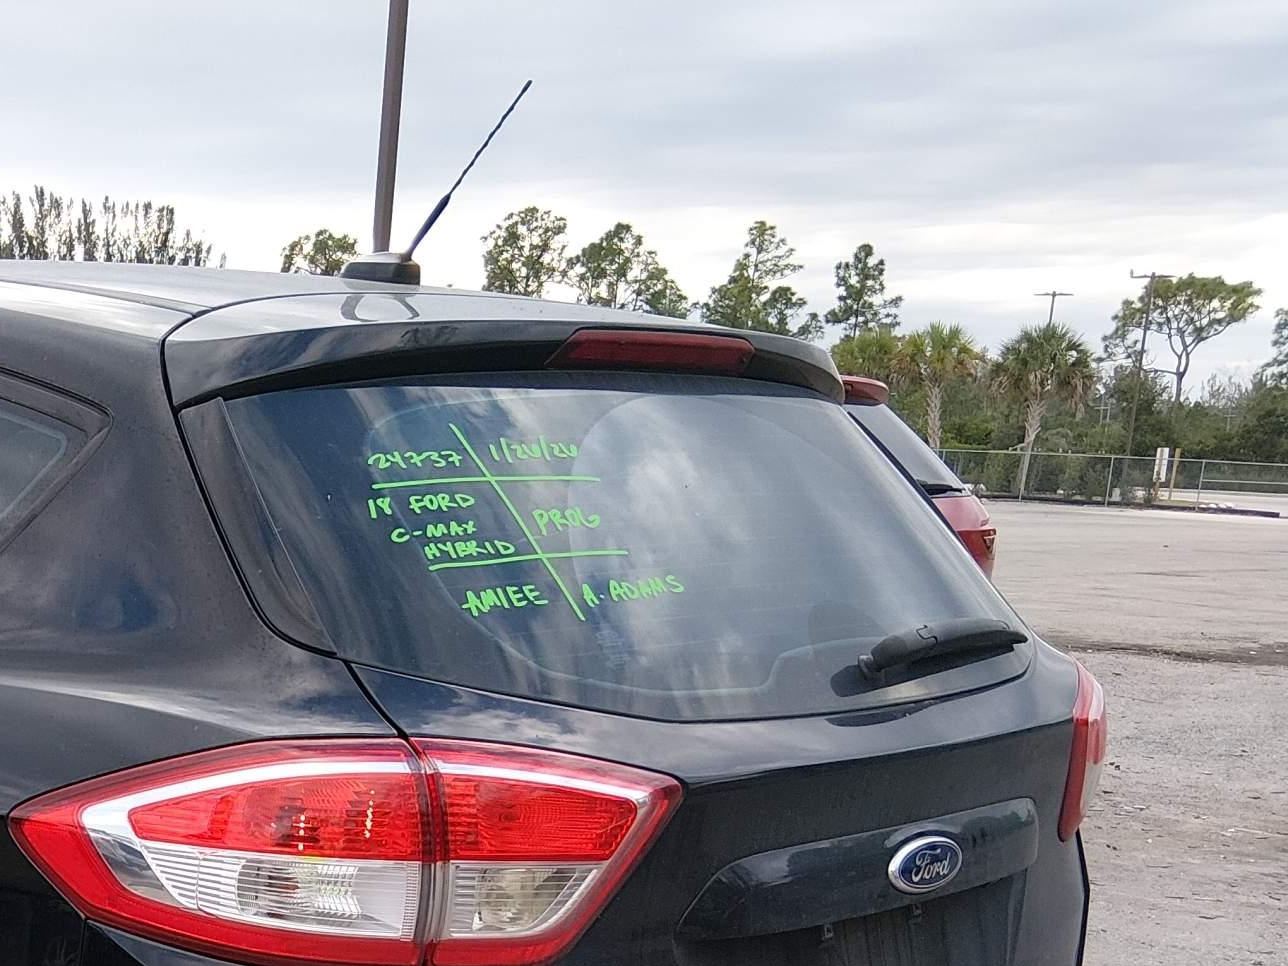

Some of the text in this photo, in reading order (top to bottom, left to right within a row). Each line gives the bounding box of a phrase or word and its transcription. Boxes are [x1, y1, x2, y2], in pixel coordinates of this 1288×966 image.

[368, 451, 462, 469] 24737
[409, 493, 475, 514] FORD
[391, 520, 477, 543] C-MAX
[424, 540, 515, 560] HYBRID
[609, 575, 685, 602] ADAMS
[462, 585, 549, 617] AMIEE
[912, 848, 951, 882] Ford
